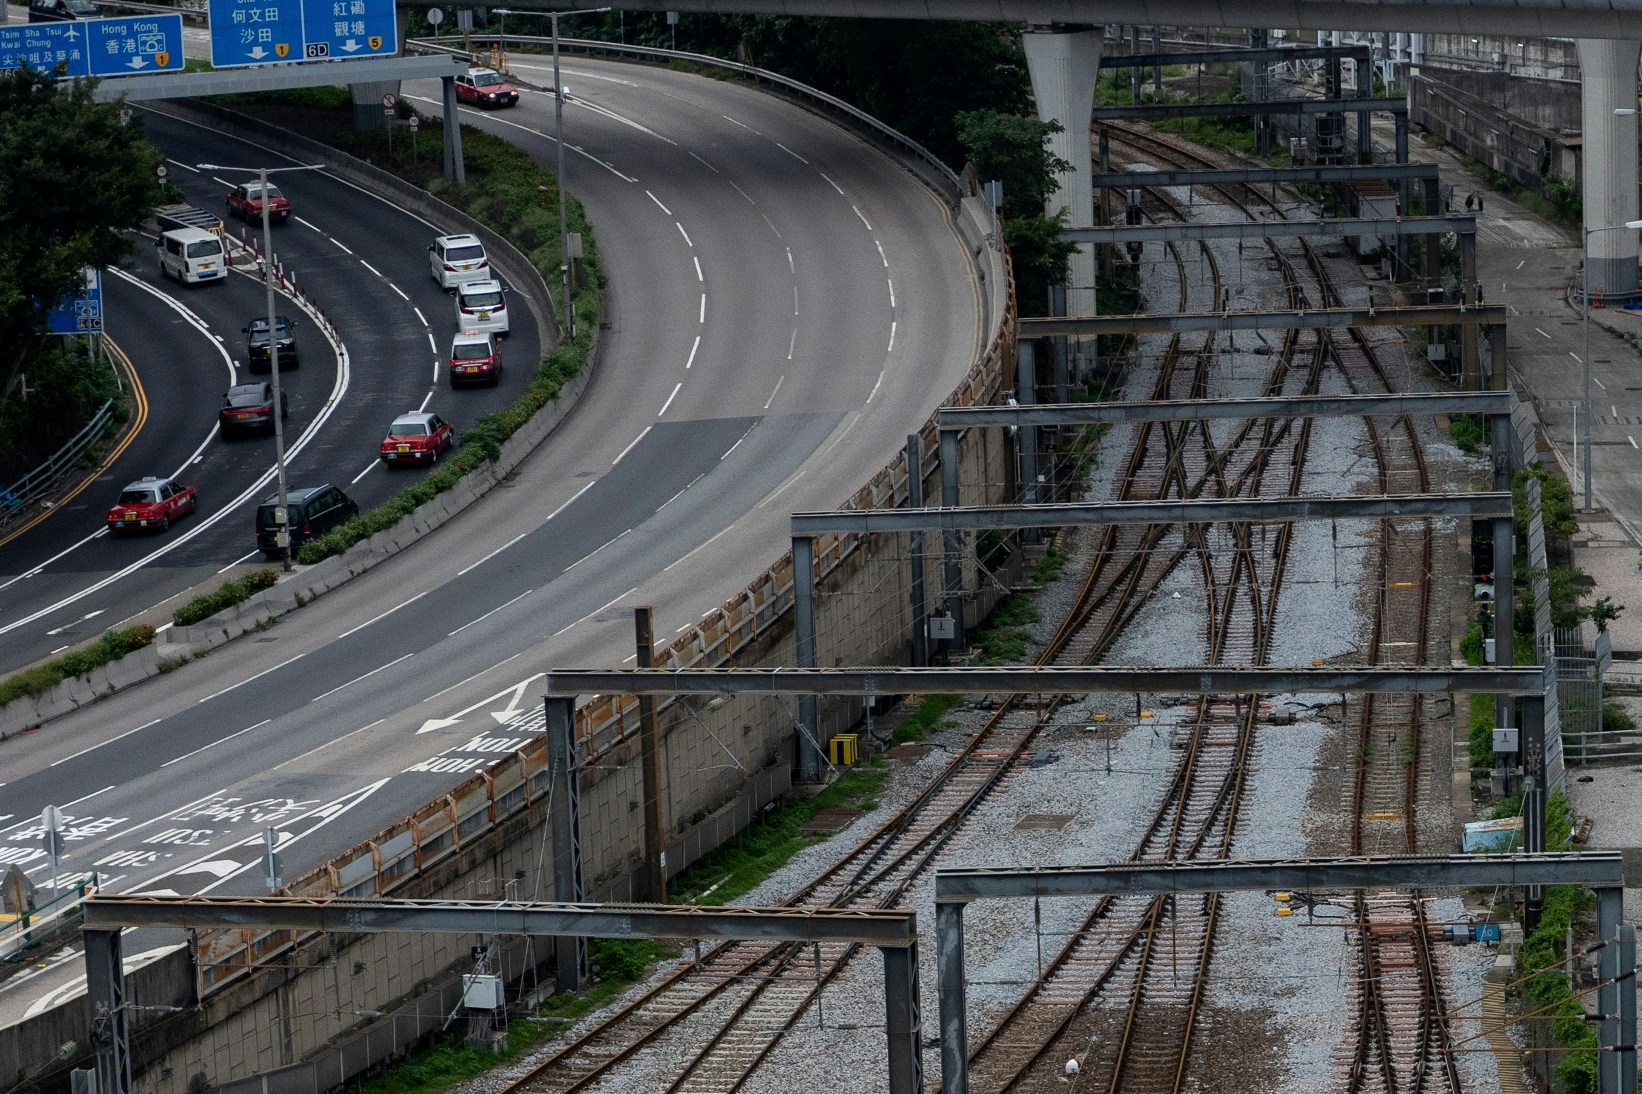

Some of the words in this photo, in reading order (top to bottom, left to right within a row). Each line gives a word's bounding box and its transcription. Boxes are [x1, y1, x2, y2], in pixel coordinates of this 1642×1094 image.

[232, 7, 279, 24] 何文田
[1, 30, 20, 39] Tsim
[25, 29, 41, 38] Sha
[46, 28, 62, 36] Tsui
[101, 24, 127, 35] Hong
[133, 22, 158, 33] Kong
[334, 21, 366, 37] 觀塘
[240, 28, 272, 44] 沙田
[1, 40, 21, 49] Kwai
[26, 39, 52, 49] Chung
[105, 38, 137, 54] 香港
[371, 38, 379, 48] 5
[279, 45, 285, 55] 1
[308, 44, 328, 58] 6D
[159, 54, 165, 65] 1
